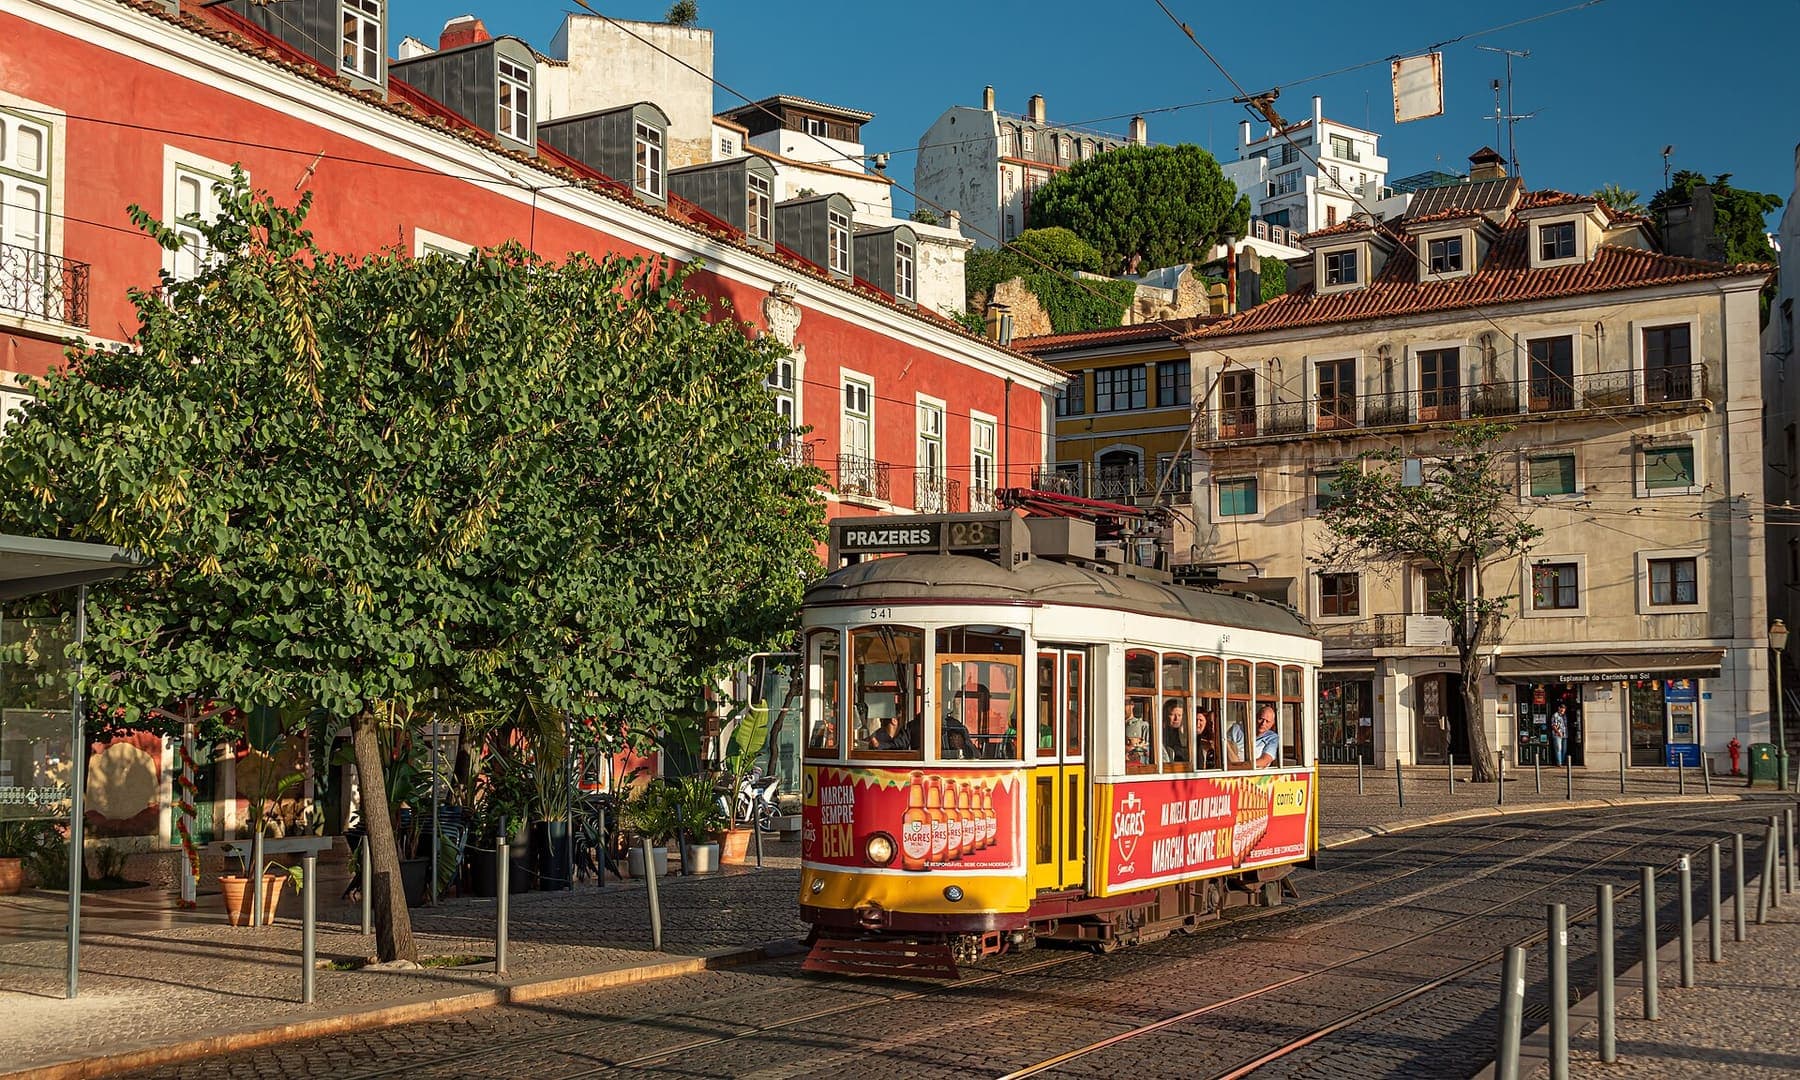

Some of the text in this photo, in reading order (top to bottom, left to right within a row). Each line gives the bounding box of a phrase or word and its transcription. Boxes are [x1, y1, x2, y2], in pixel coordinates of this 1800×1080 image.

[846, 529, 931, 546] PRAZERES
[952, 522, 984, 545] 28
[870, 607, 891, 619] 541
[821, 785, 855, 805] MARCHA
[821, 804, 855, 825] SEMPRE
[1113, 810, 1146, 840] SAGRES
[822, 824, 854, 857] BEM
[903, 832, 931, 843] SAGRES
[1151, 835, 1184, 874] MARCHA
[1186, 829, 1216, 866] SEMPRE
[1216, 827, 1232, 859] BEM
